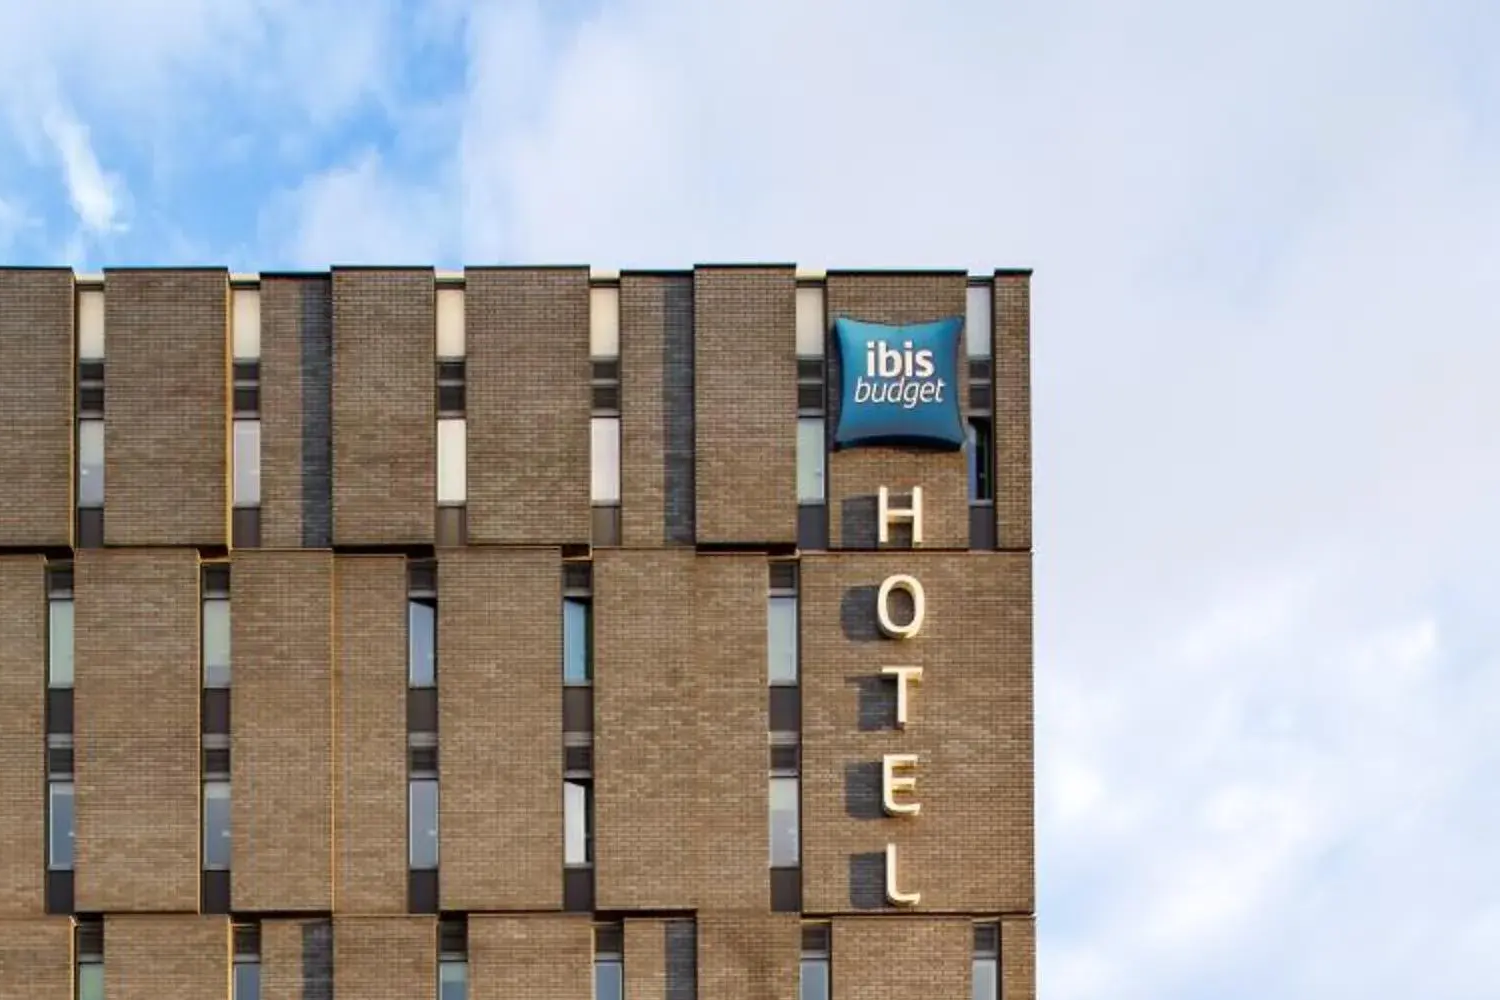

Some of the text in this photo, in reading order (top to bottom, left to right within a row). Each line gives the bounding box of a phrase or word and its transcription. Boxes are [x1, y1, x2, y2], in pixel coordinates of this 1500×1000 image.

[866, 340, 935, 377] ibis
[854, 375, 945, 409] budget
[877, 485, 925, 906] HOTEL
